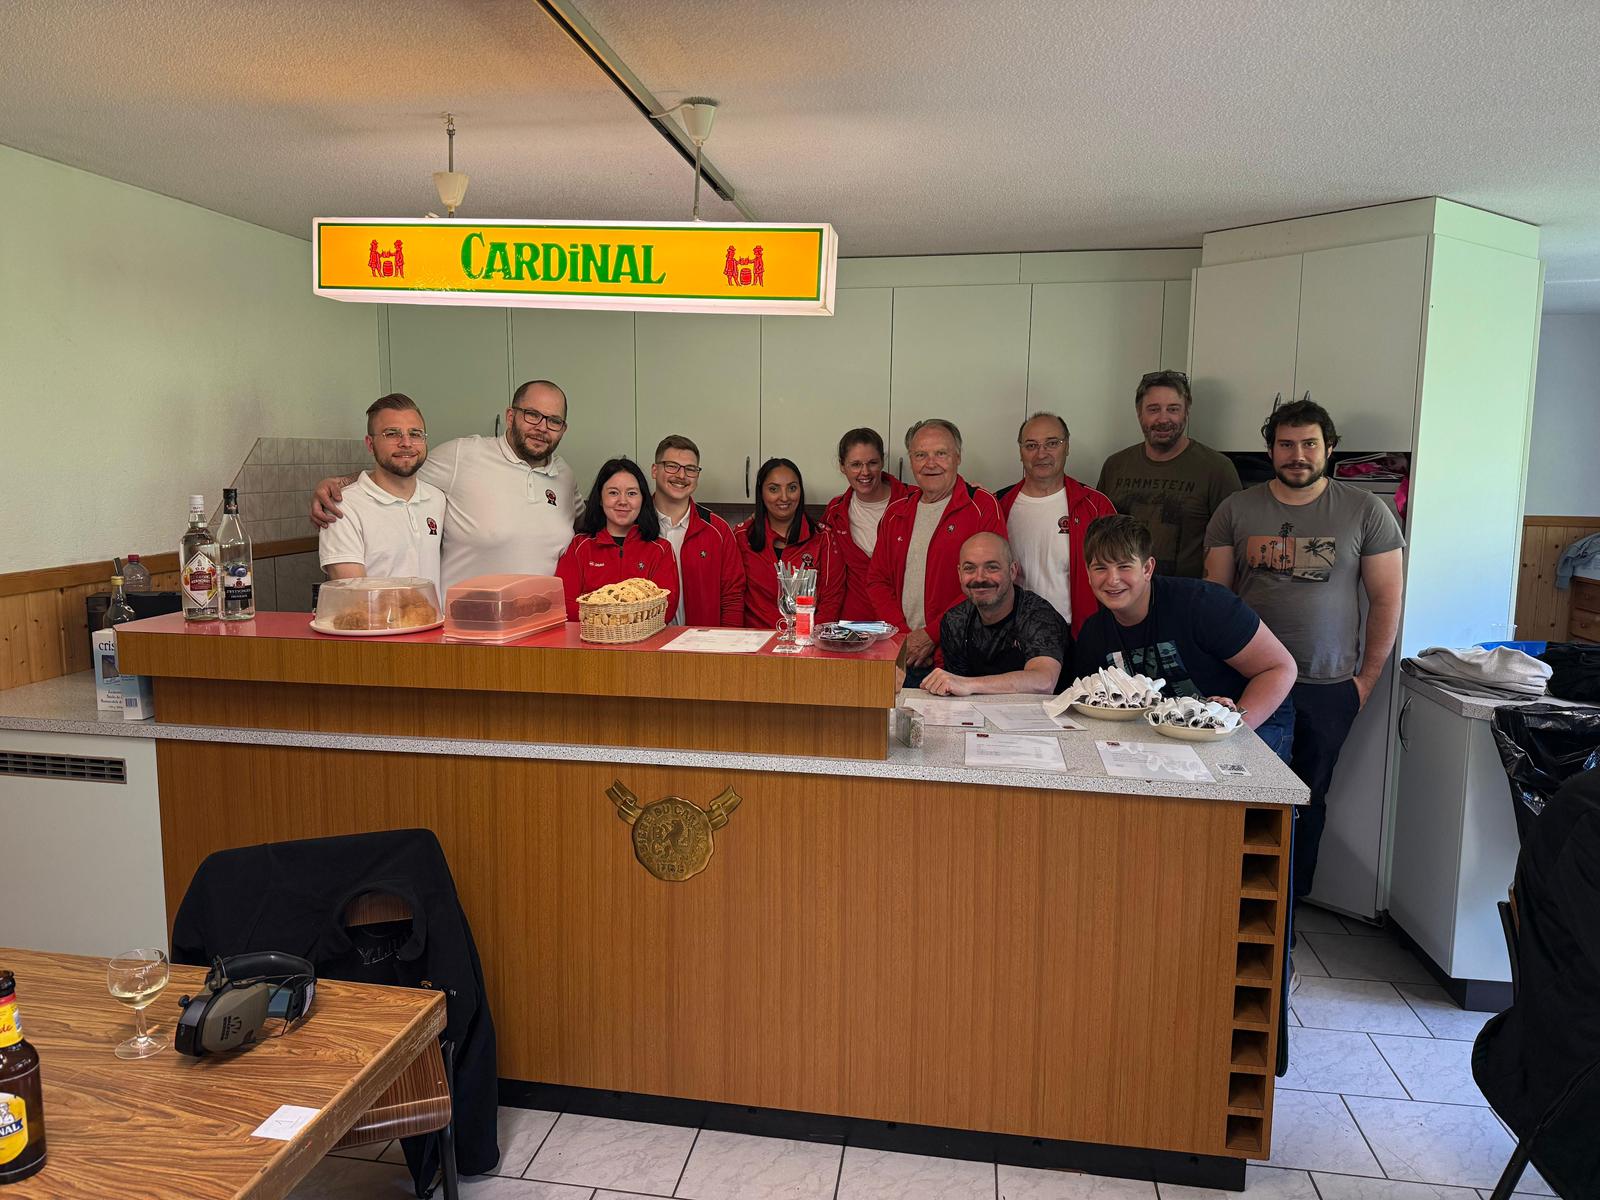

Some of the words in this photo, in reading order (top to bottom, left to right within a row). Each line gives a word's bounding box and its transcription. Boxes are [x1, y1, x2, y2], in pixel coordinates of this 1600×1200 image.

[1115, 477, 1196, 493] RAMMSTEIN
[98, 640, 115, 651] cris
[0, 1123, 20, 1136] NAL
